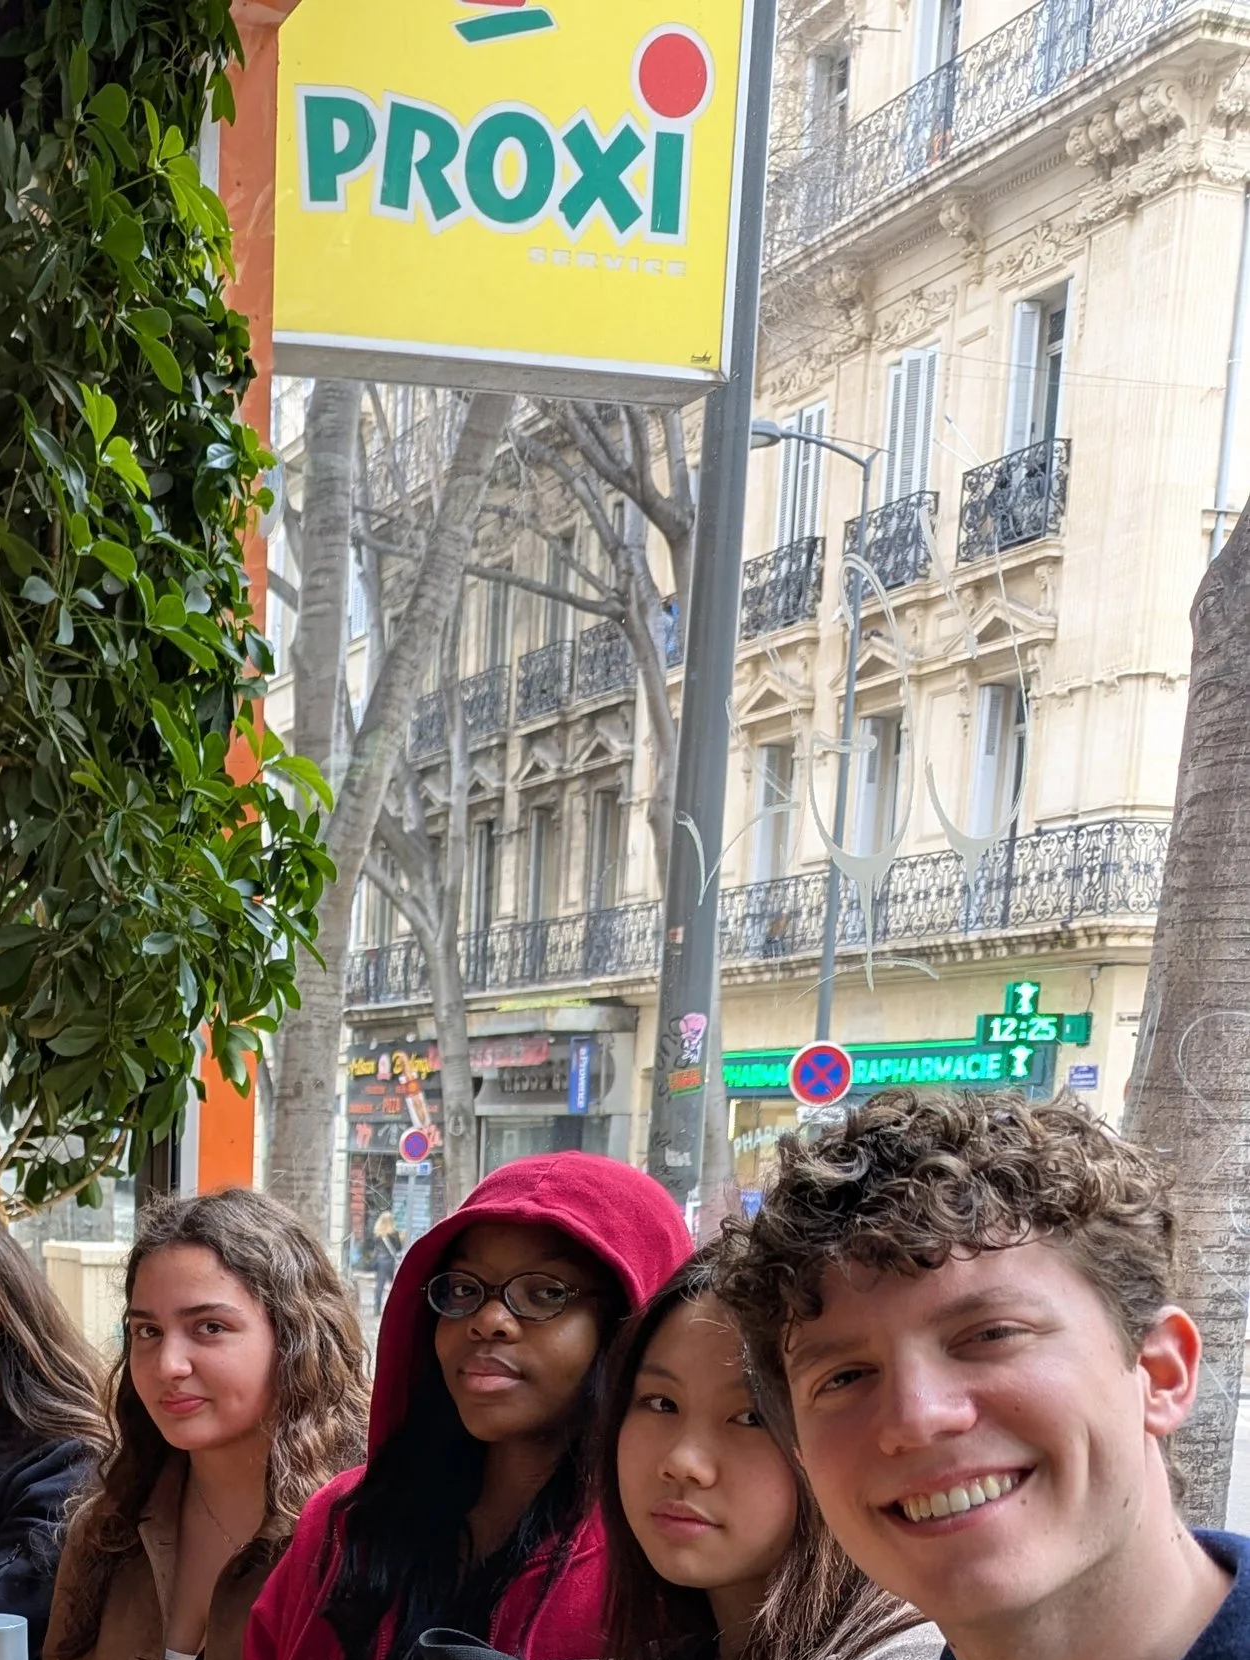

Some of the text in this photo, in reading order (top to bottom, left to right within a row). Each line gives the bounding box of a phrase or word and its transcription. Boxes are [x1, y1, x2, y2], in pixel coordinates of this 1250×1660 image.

[528, 246, 687, 277] SERVICE
[989, 1017, 1058, 1042] 12:25
[723, 1063, 791, 1087] PHARMA
[852, 1053, 1002, 1084] RAPHARMACIE
